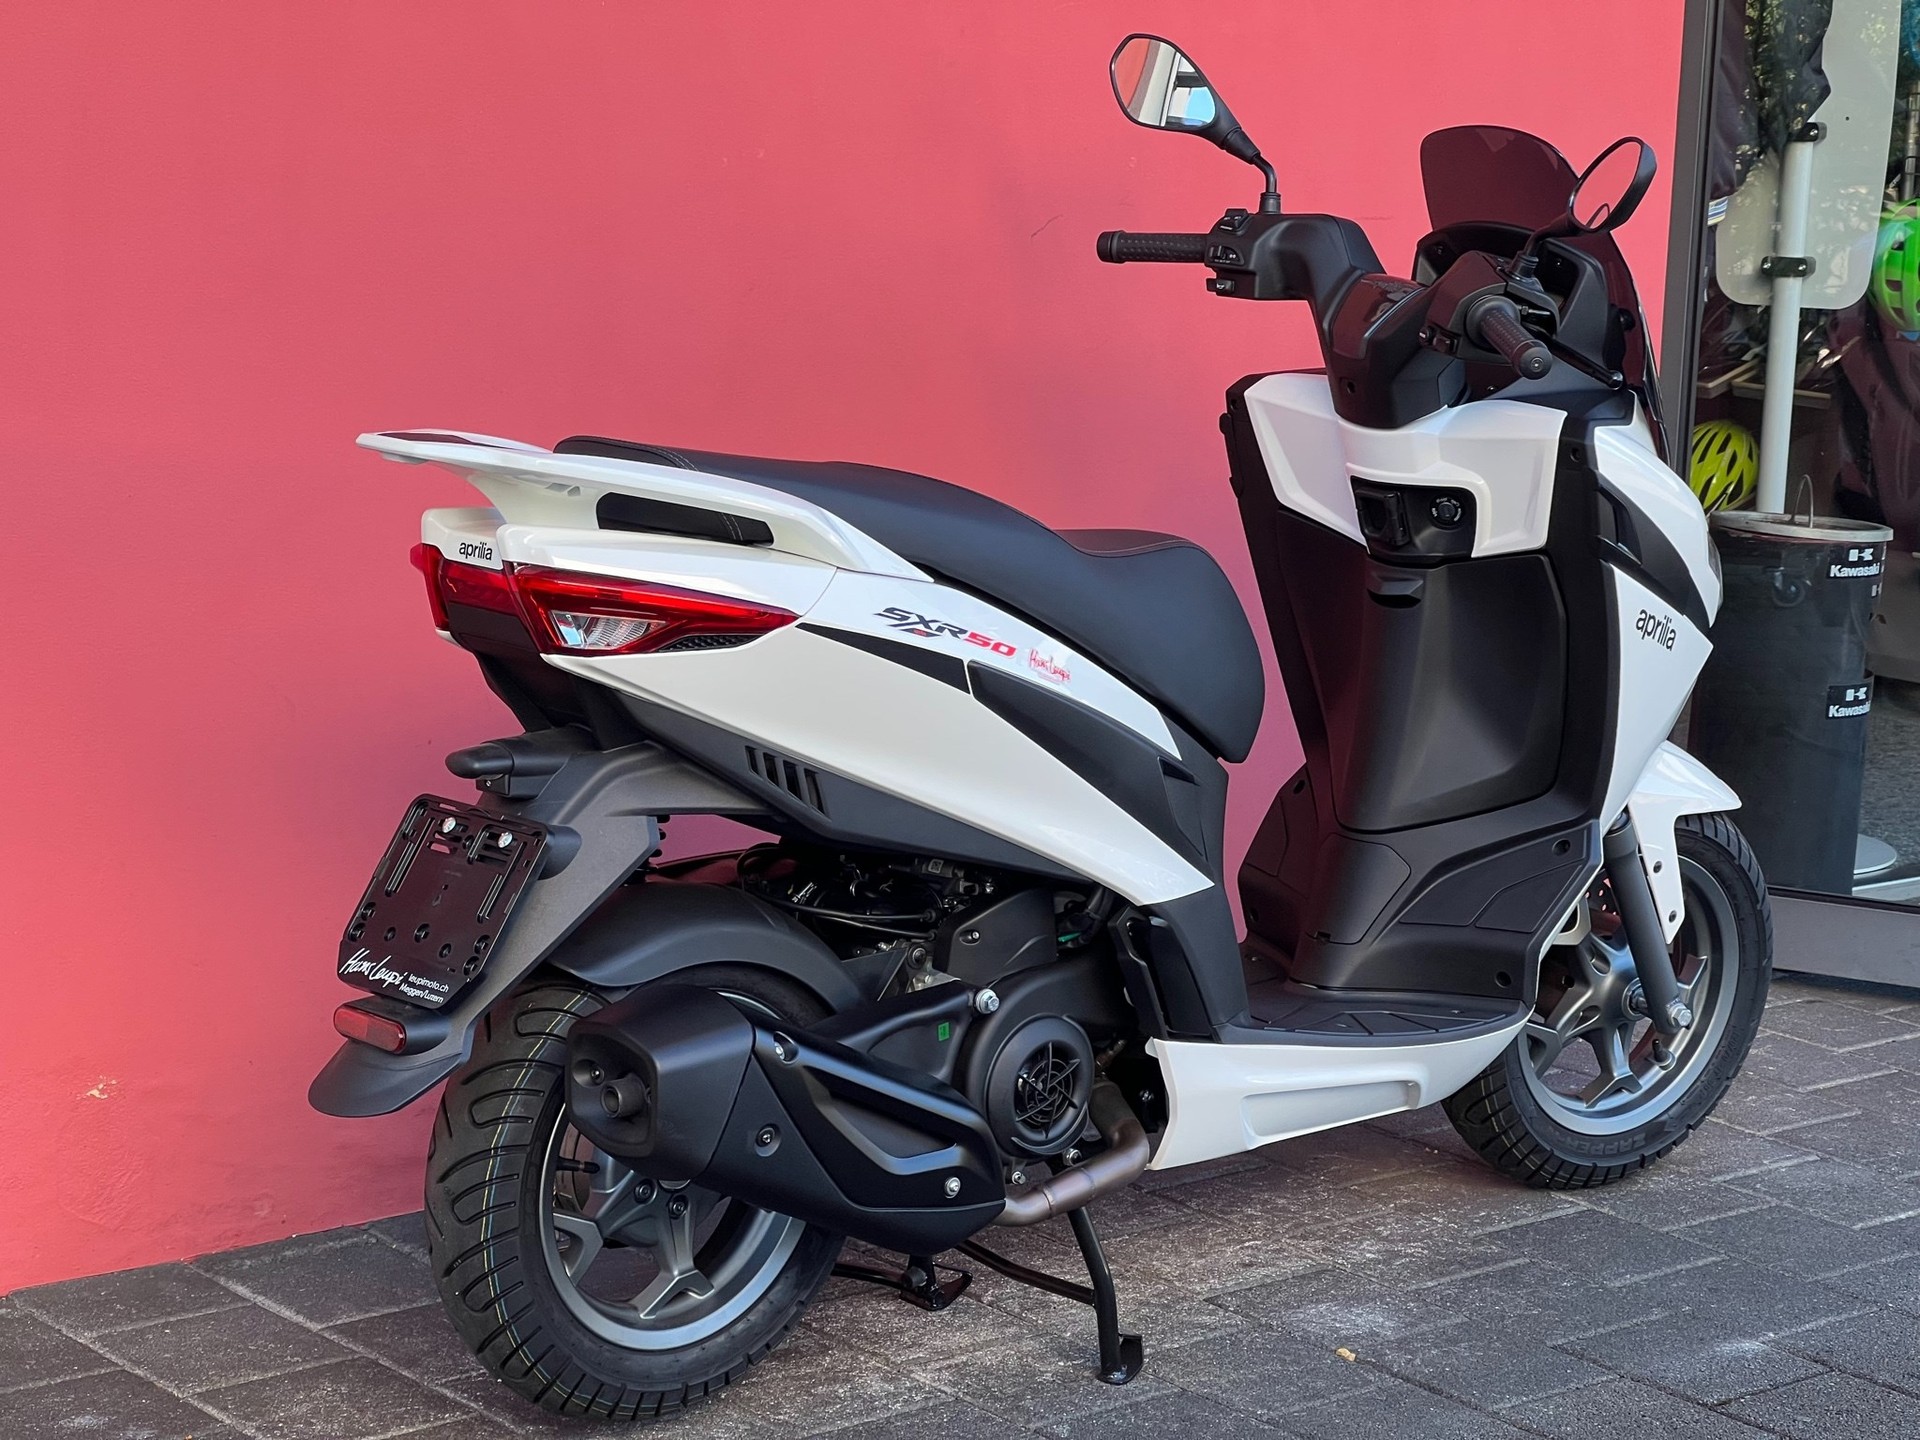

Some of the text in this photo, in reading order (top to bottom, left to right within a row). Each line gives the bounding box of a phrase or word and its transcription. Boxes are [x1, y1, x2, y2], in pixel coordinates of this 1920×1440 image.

[459, 541, 493, 561] aprilia
[1829, 562, 1881, 578] Kawasaki
[1635, 608, 1677, 652] aprilia
[1828, 700, 1871, 718] Kawasaki
[338, 947, 377, 975] Hans
[398, 982, 444, 1003] Meggen/Luzern
[408, 973, 449, 993] leupimoto.ch
